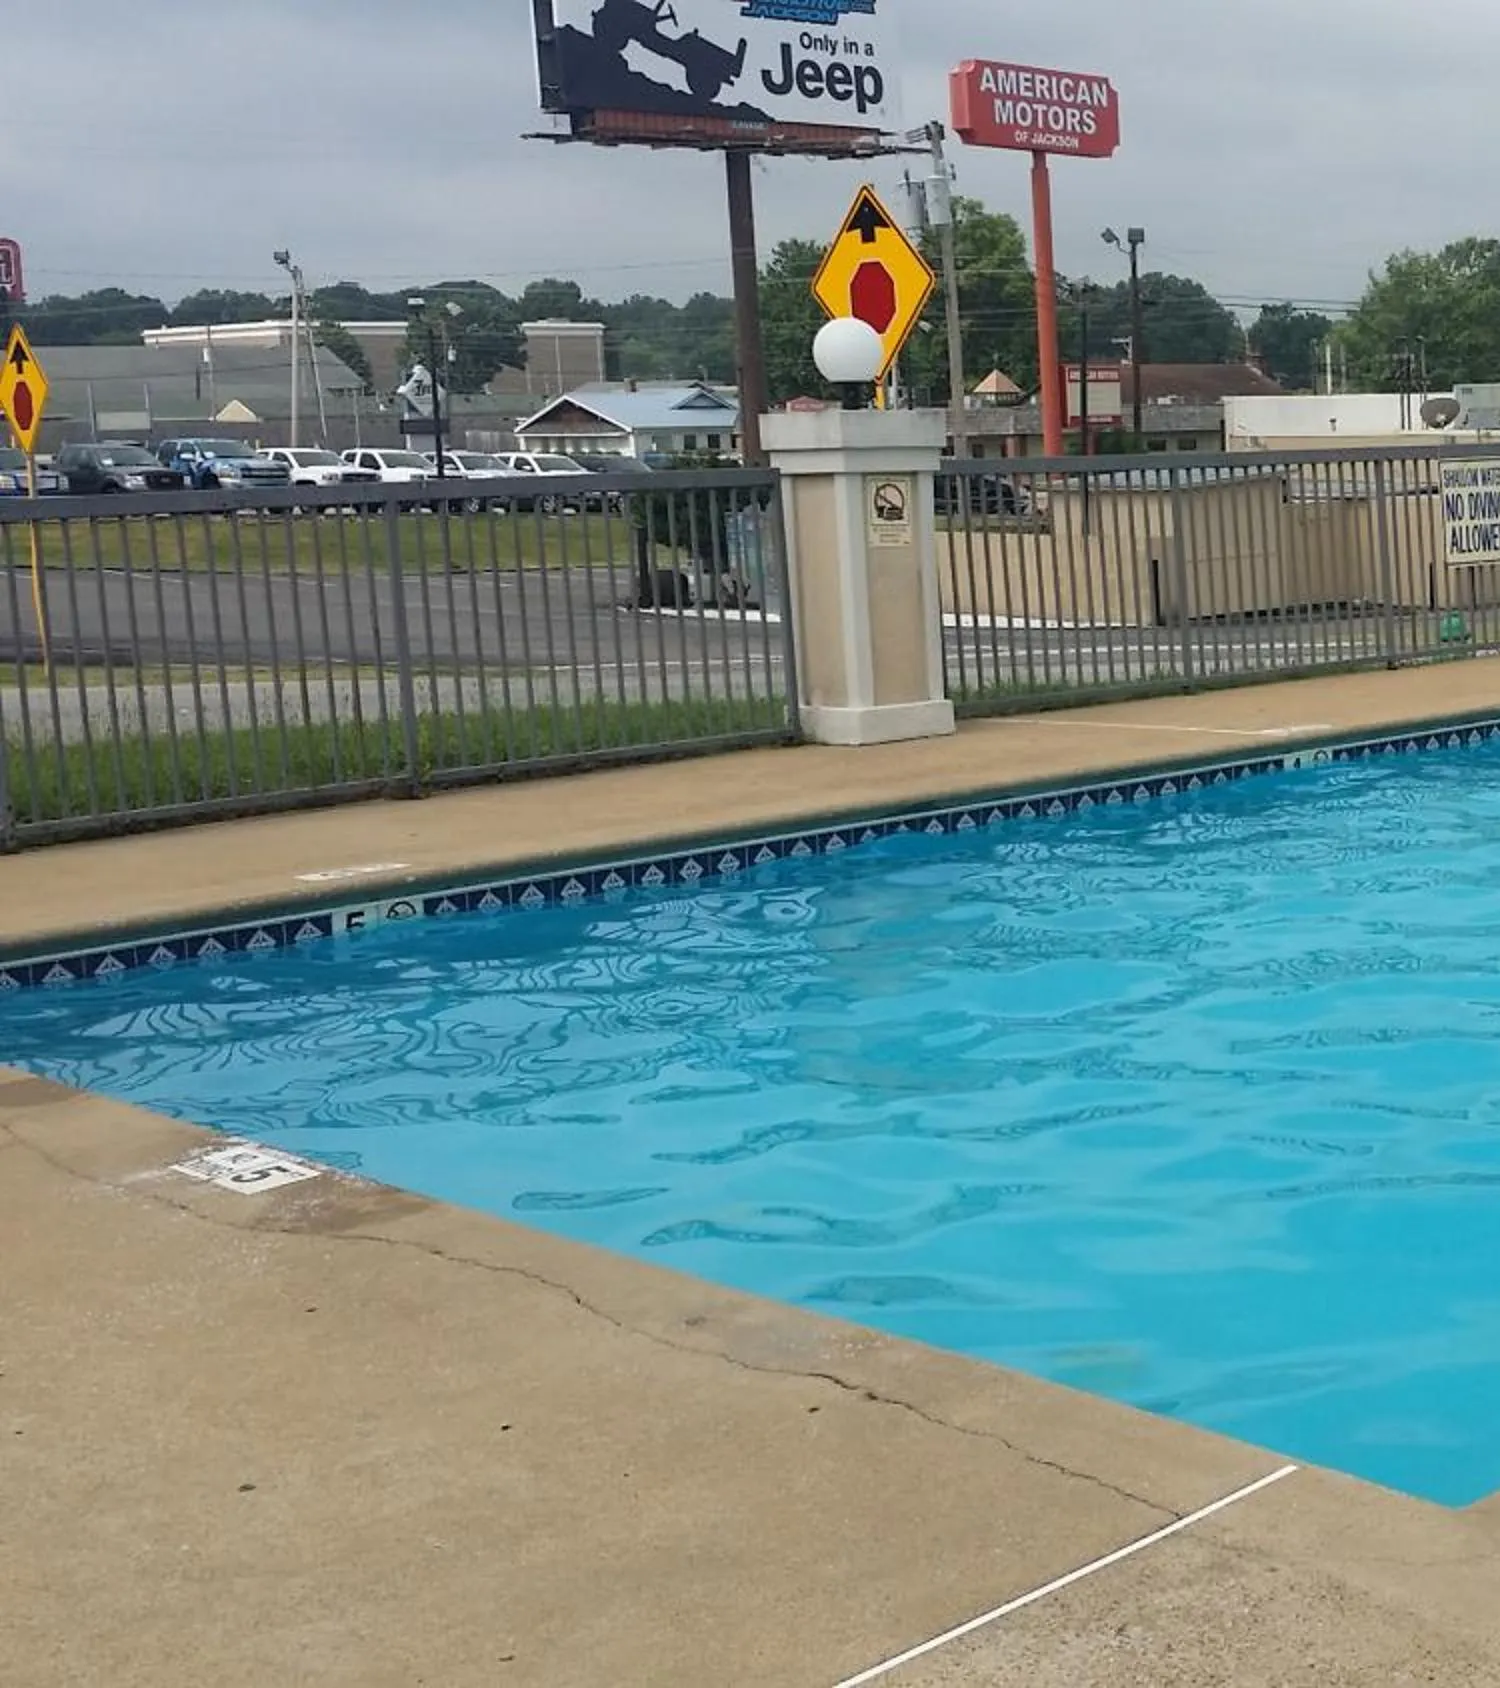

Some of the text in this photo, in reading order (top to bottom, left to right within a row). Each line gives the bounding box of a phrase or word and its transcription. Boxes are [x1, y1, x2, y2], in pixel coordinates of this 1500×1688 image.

[800, 32, 874, 56] Only in a
[761, 42, 883, 113] Jeep
[980, 67, 1108, 108] AMERICAN
[994, 99, 1097, 135] MOTORS
[1014, 130, 1079, 149] OF JACKSON
[1445, 493, 1464, 520] NO
